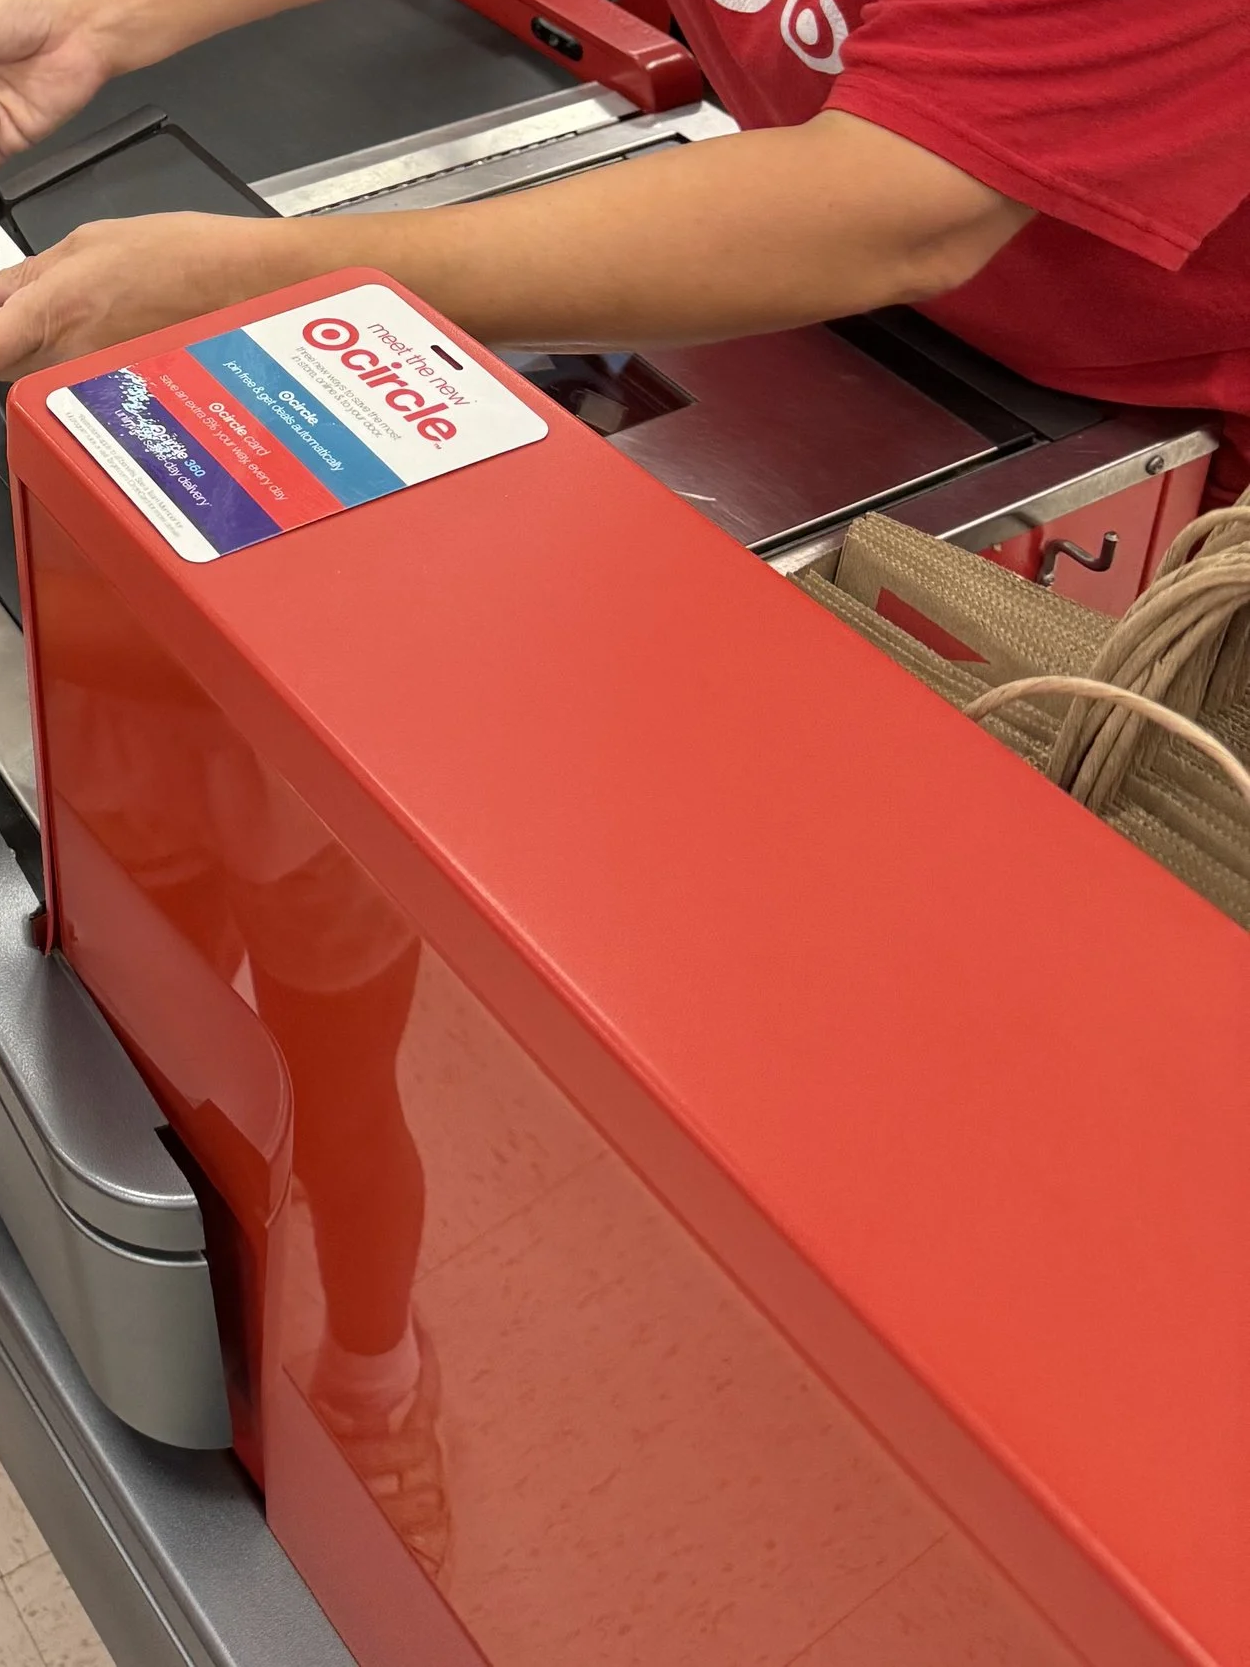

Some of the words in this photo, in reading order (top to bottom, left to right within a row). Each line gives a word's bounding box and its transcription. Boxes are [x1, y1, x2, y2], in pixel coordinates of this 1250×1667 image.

[222, 360, 241, 376] join
[239, 370, 256, 388] free
[367, 323, 414, 356] meet
[405, 354, 435, 377] the
[429, 377, 471, 407] new
[253, 385, 265, 395] &
[257, 391, 277, 406] get
[312, 359, 330, 376] new
[326, 372, 347, 393] ways
[343, 387, 356, 400] to
[351, 395, 371, 414] save
[367, 409, 384, 425] the
[379, 420, 402, 442] most
[272, 404, 296, 425] deals
[314, 375, 337, 396] online
[333, 391, 344, 402] &
[340, 397, 352, 409] to
[346, 405, 367, 425] your
[362, 419, 384, 439] door.
[160, 374, 180, 392] save
[175, 389, 189, 401] an
[185, 399, 206, 420] extra
[214, 431, 236, 448] your
[248, 462, 272, 485] every
[269, 483, 289, 502] day
[219, 412, 248, 437] circle
[244, 436, 271, 457] card
[291, 423, 345, 472] automatically
[184, 458, 206, 478] 360
